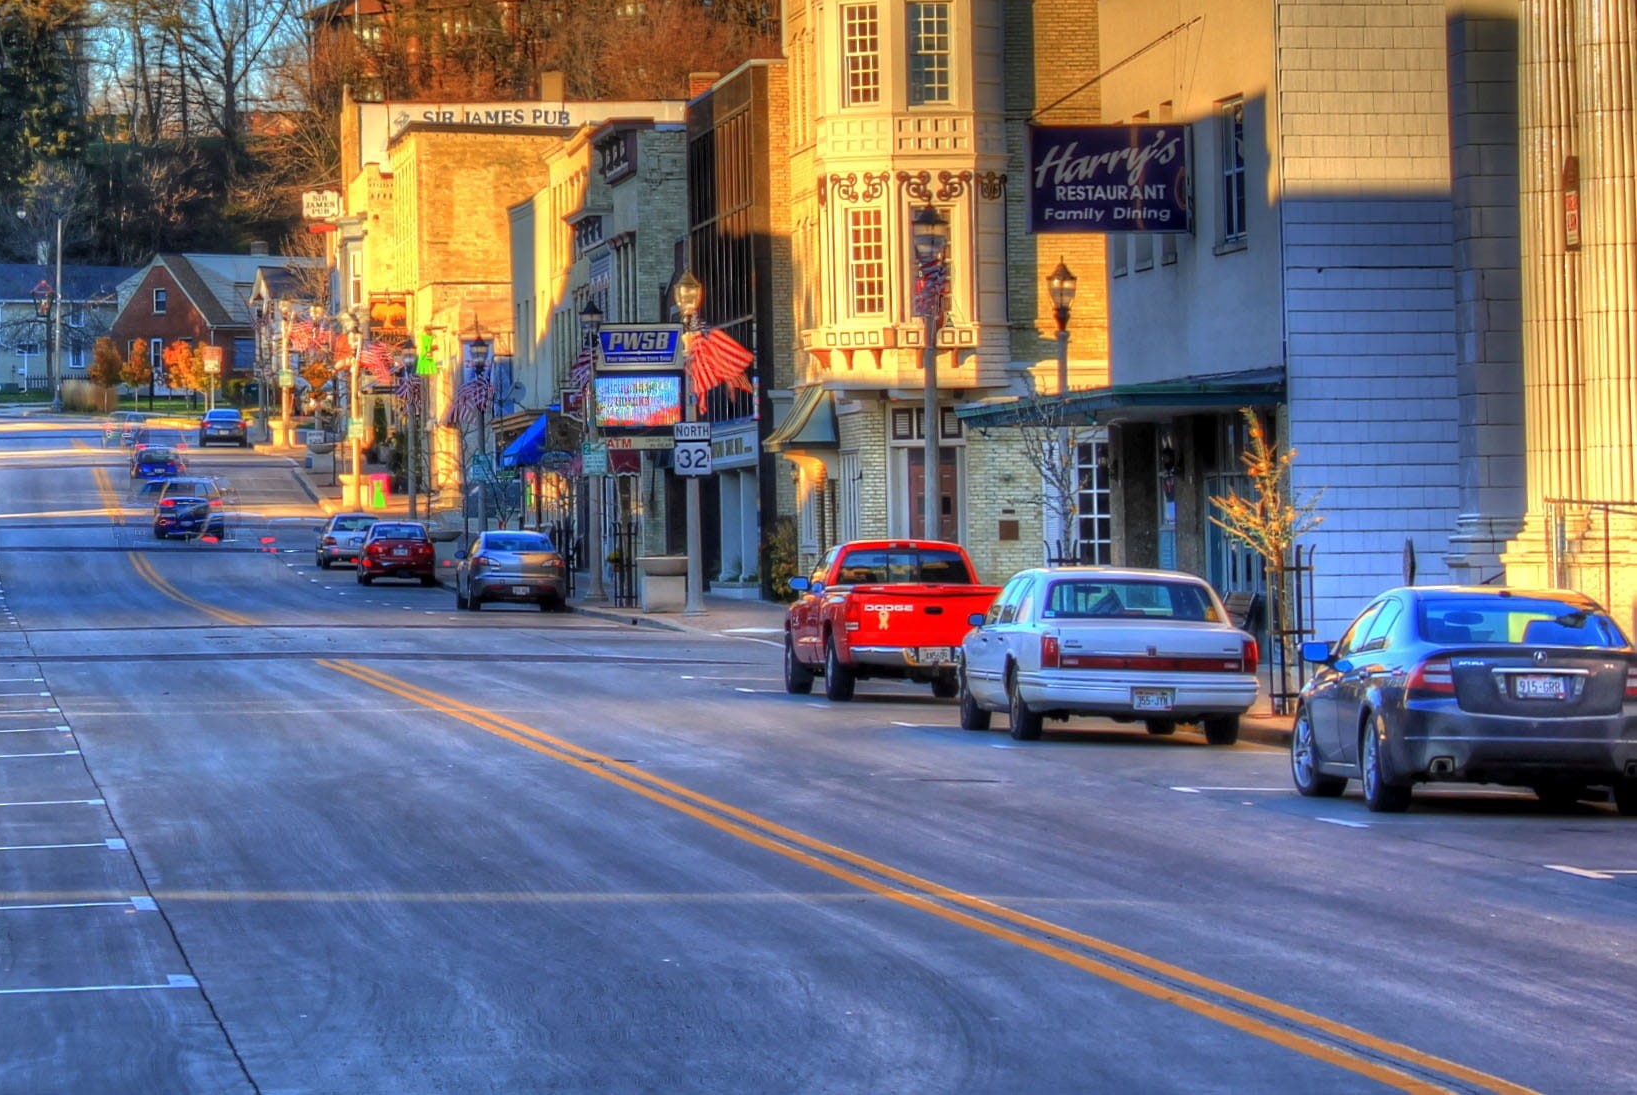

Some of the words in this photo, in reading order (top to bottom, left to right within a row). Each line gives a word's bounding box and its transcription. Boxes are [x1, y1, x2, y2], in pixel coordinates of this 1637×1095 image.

[423, 110, 454, 123] SIR
[465, 109, 524, 124] JAMES
[532, 110, 570, 125] PUB
[1035, 130, 1180, 188] Harry's
[1056, 185, 1166, 201] RESTAURANT
[1044, 208, 1105, 222] Family
[1114, 208, 1171, 221] Dining
[608, 332, 670, 350] PWSB
[675, 426, 709, 437] NORTH
[607, 439, 632, 448] ATM
[679, 449, 707, 468] 32
[864, 604, 913, 612] DODGE
[1520, 680, 1561, 693] 915-GRR
